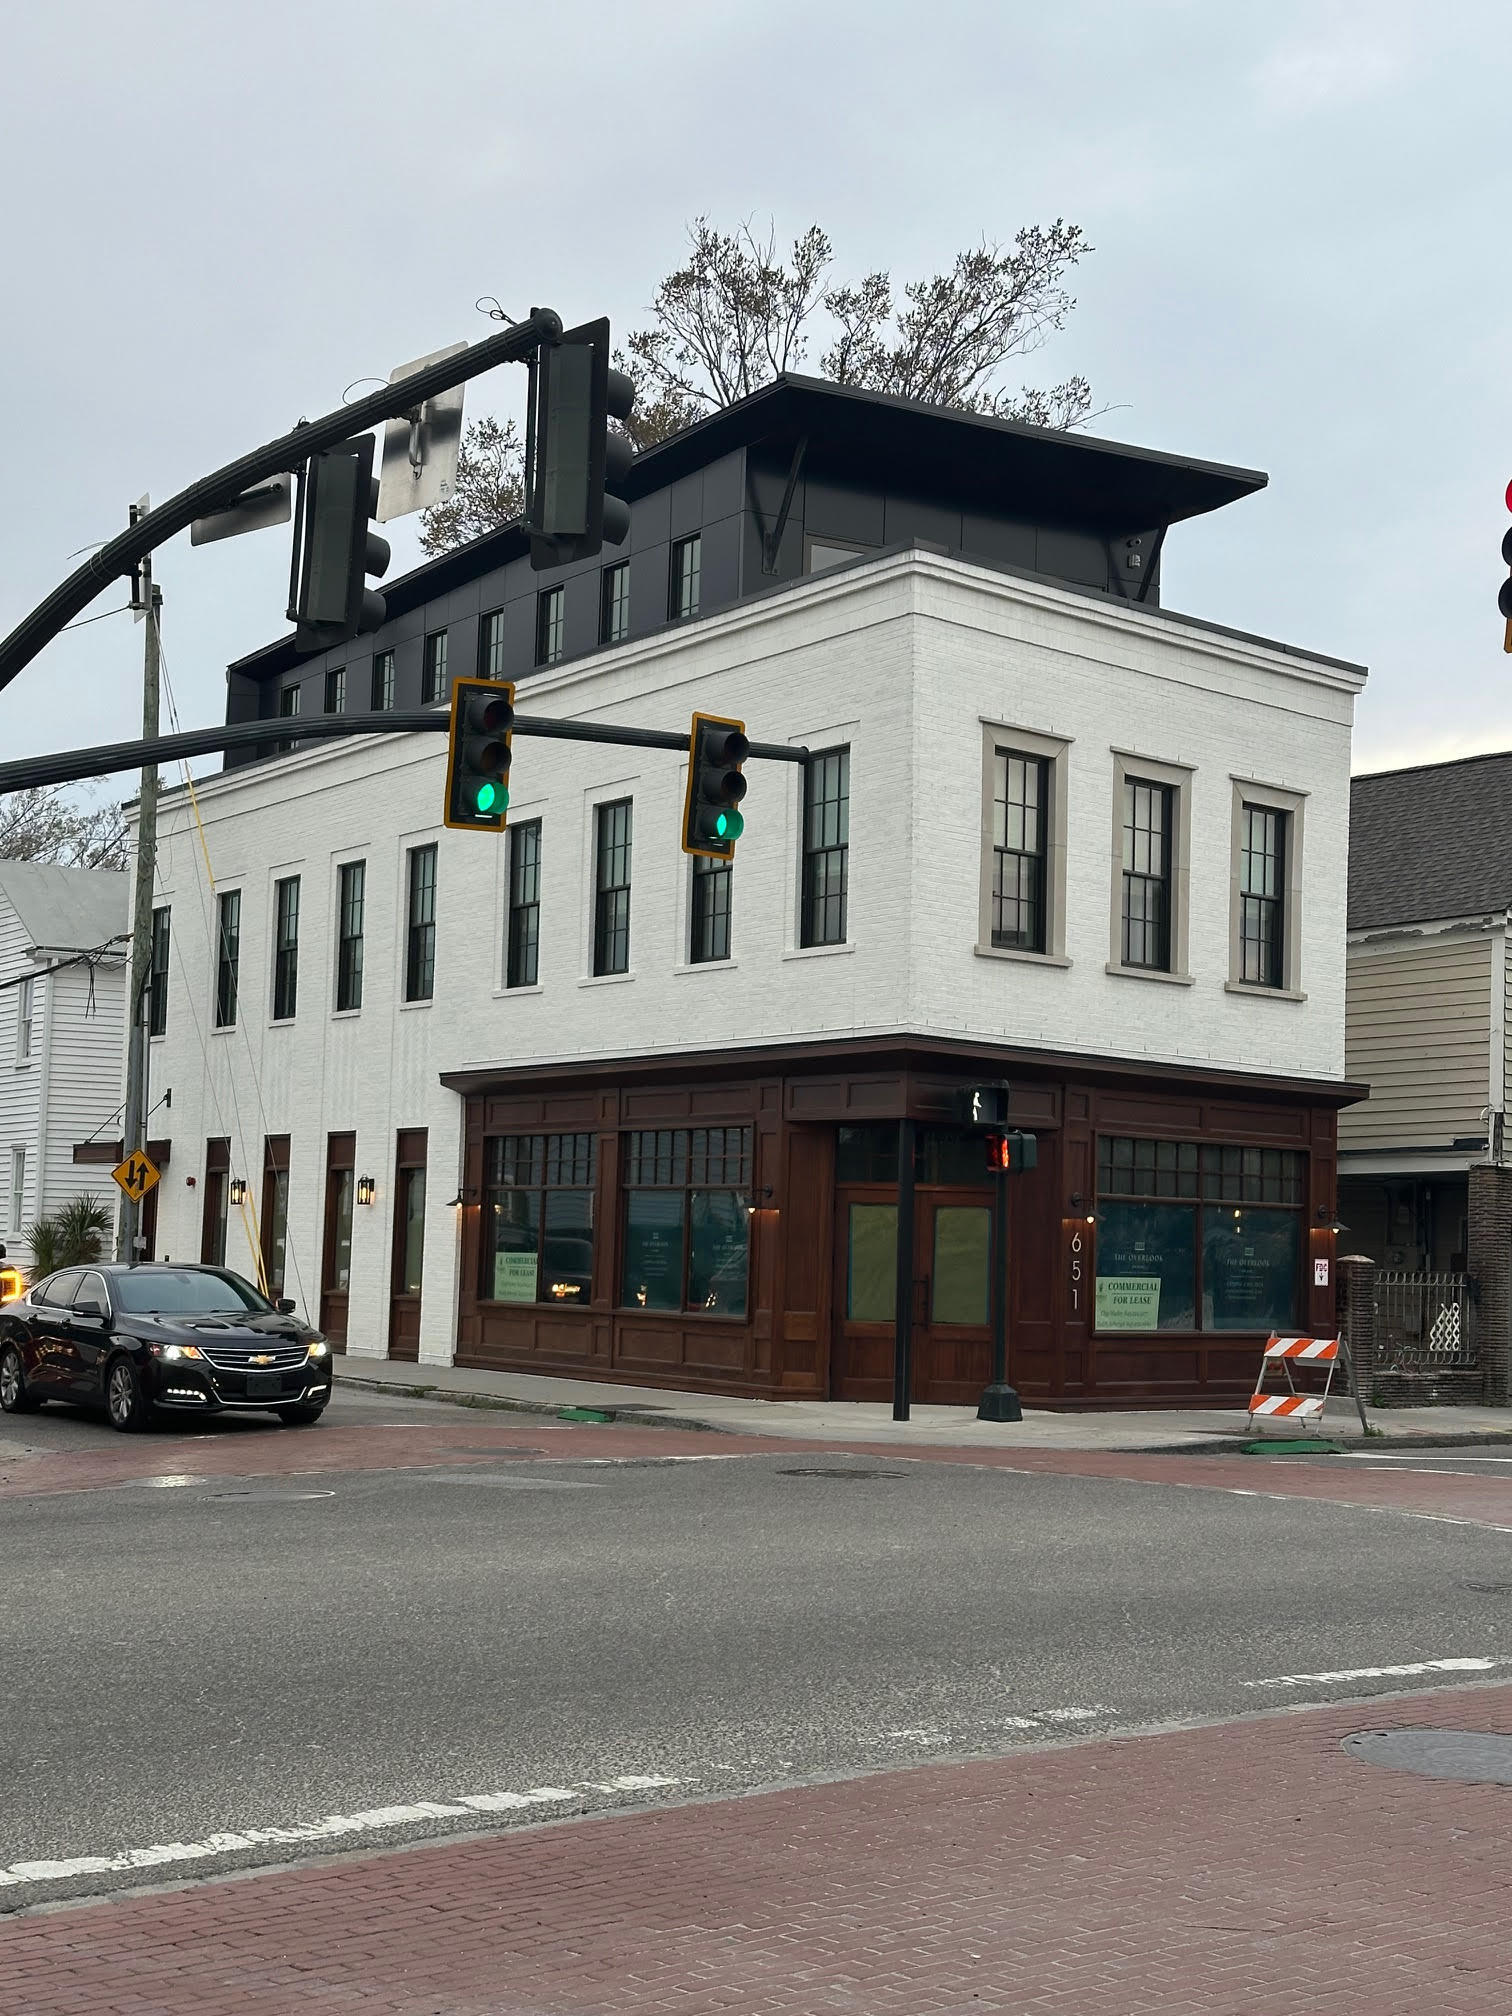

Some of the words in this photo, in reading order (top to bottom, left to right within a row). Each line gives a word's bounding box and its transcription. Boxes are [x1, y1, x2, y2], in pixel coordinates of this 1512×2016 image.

[1128, 1254, 1163, 1262] OVERLOOK
[1072, 1232, 1082, 1310] 651
[1315, 1263, 1328, 1272] FDC
[1108, 1282, 1158, 1291] COMMERCIAL
[1113, 1296, 1128, 1304] FOR
[1129, 1296, 1152, 1304] LEASE
